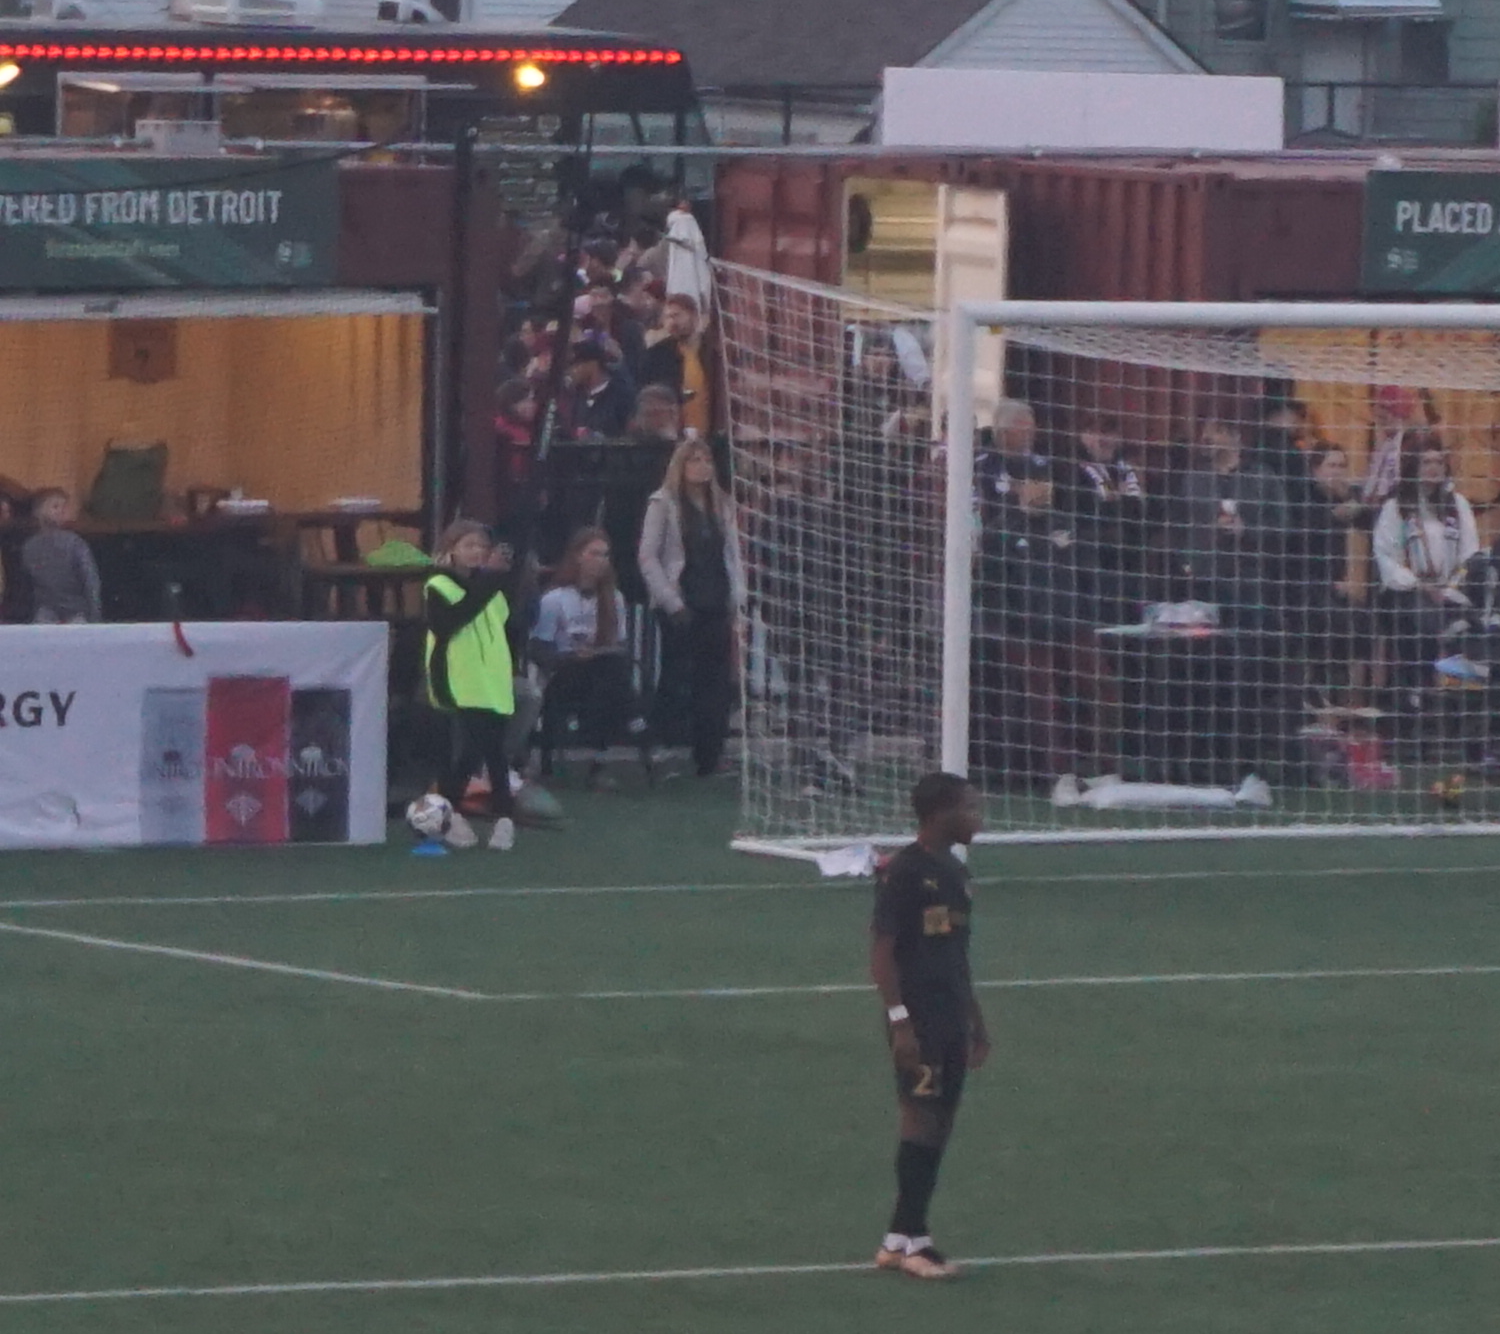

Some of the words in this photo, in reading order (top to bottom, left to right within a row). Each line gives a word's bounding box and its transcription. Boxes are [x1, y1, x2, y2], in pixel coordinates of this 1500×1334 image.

[0, 193, 76, 224] ERED
[85, 190, 159, 223] FROM
[168, 190, 282, 225] DETROIT
[1396, 201, 1492, 234] PLACED
[0, 690, 77, 728] GY
[914, 1065, 933, 1096] 2
